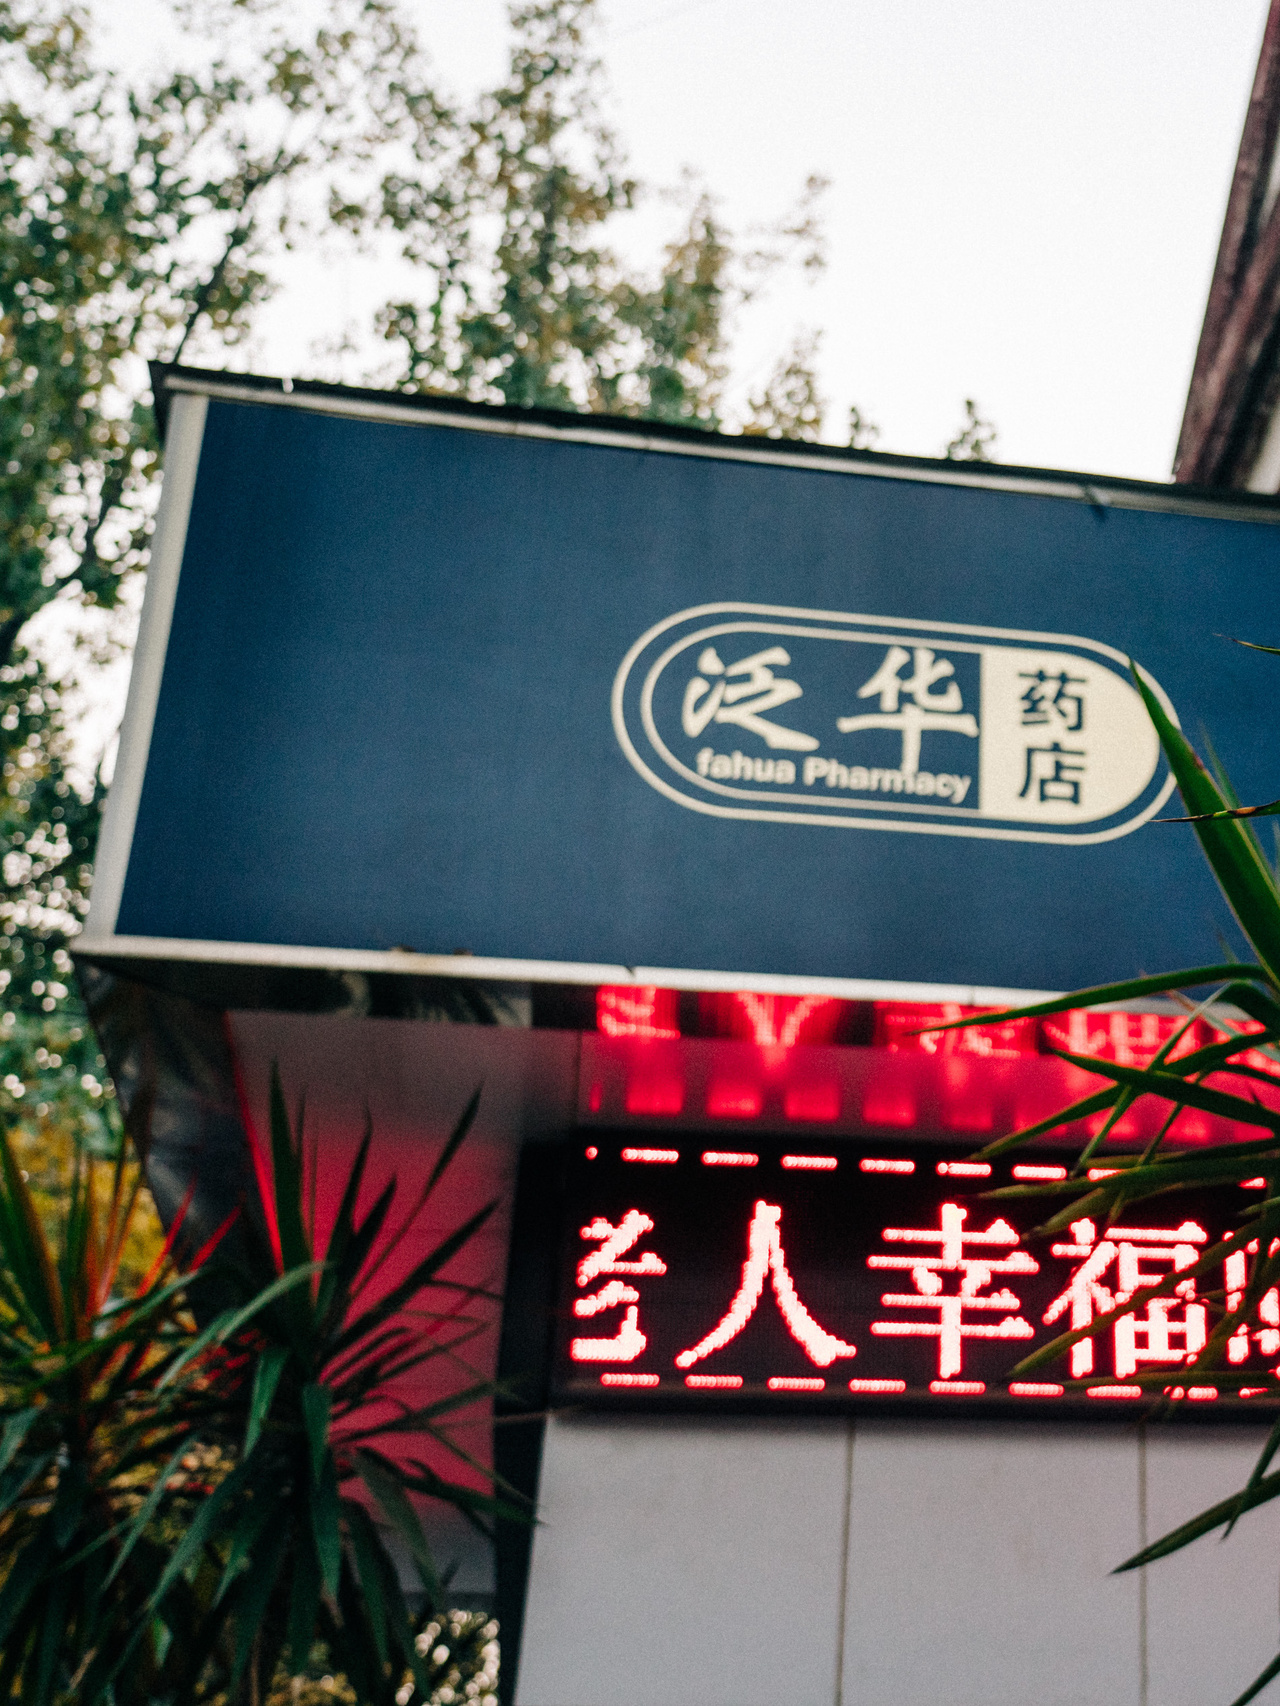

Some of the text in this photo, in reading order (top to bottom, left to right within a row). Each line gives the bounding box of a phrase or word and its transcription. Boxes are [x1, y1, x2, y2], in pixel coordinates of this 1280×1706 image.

[682, 646, 980, 772] 泛华
[1019, 669, 1087, 804] 药店
[696, 747, 971, 804] fahua Pharmacy
